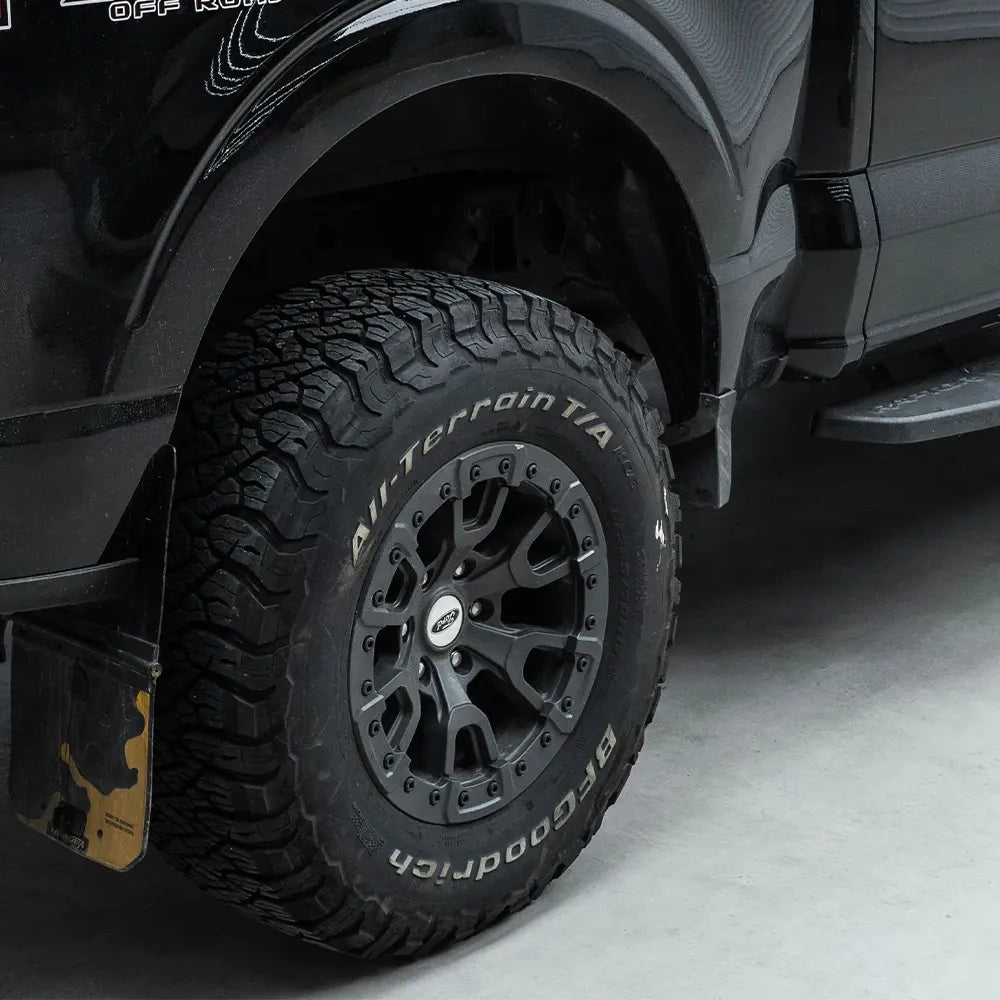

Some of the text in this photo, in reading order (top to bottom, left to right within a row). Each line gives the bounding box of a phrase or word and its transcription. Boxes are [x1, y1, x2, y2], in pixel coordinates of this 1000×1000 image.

[352, 386, 556, 567] All-Terrain
[560, 395, 614, 450] T/A
[388, 723, 617, 885] BFGoodrich
